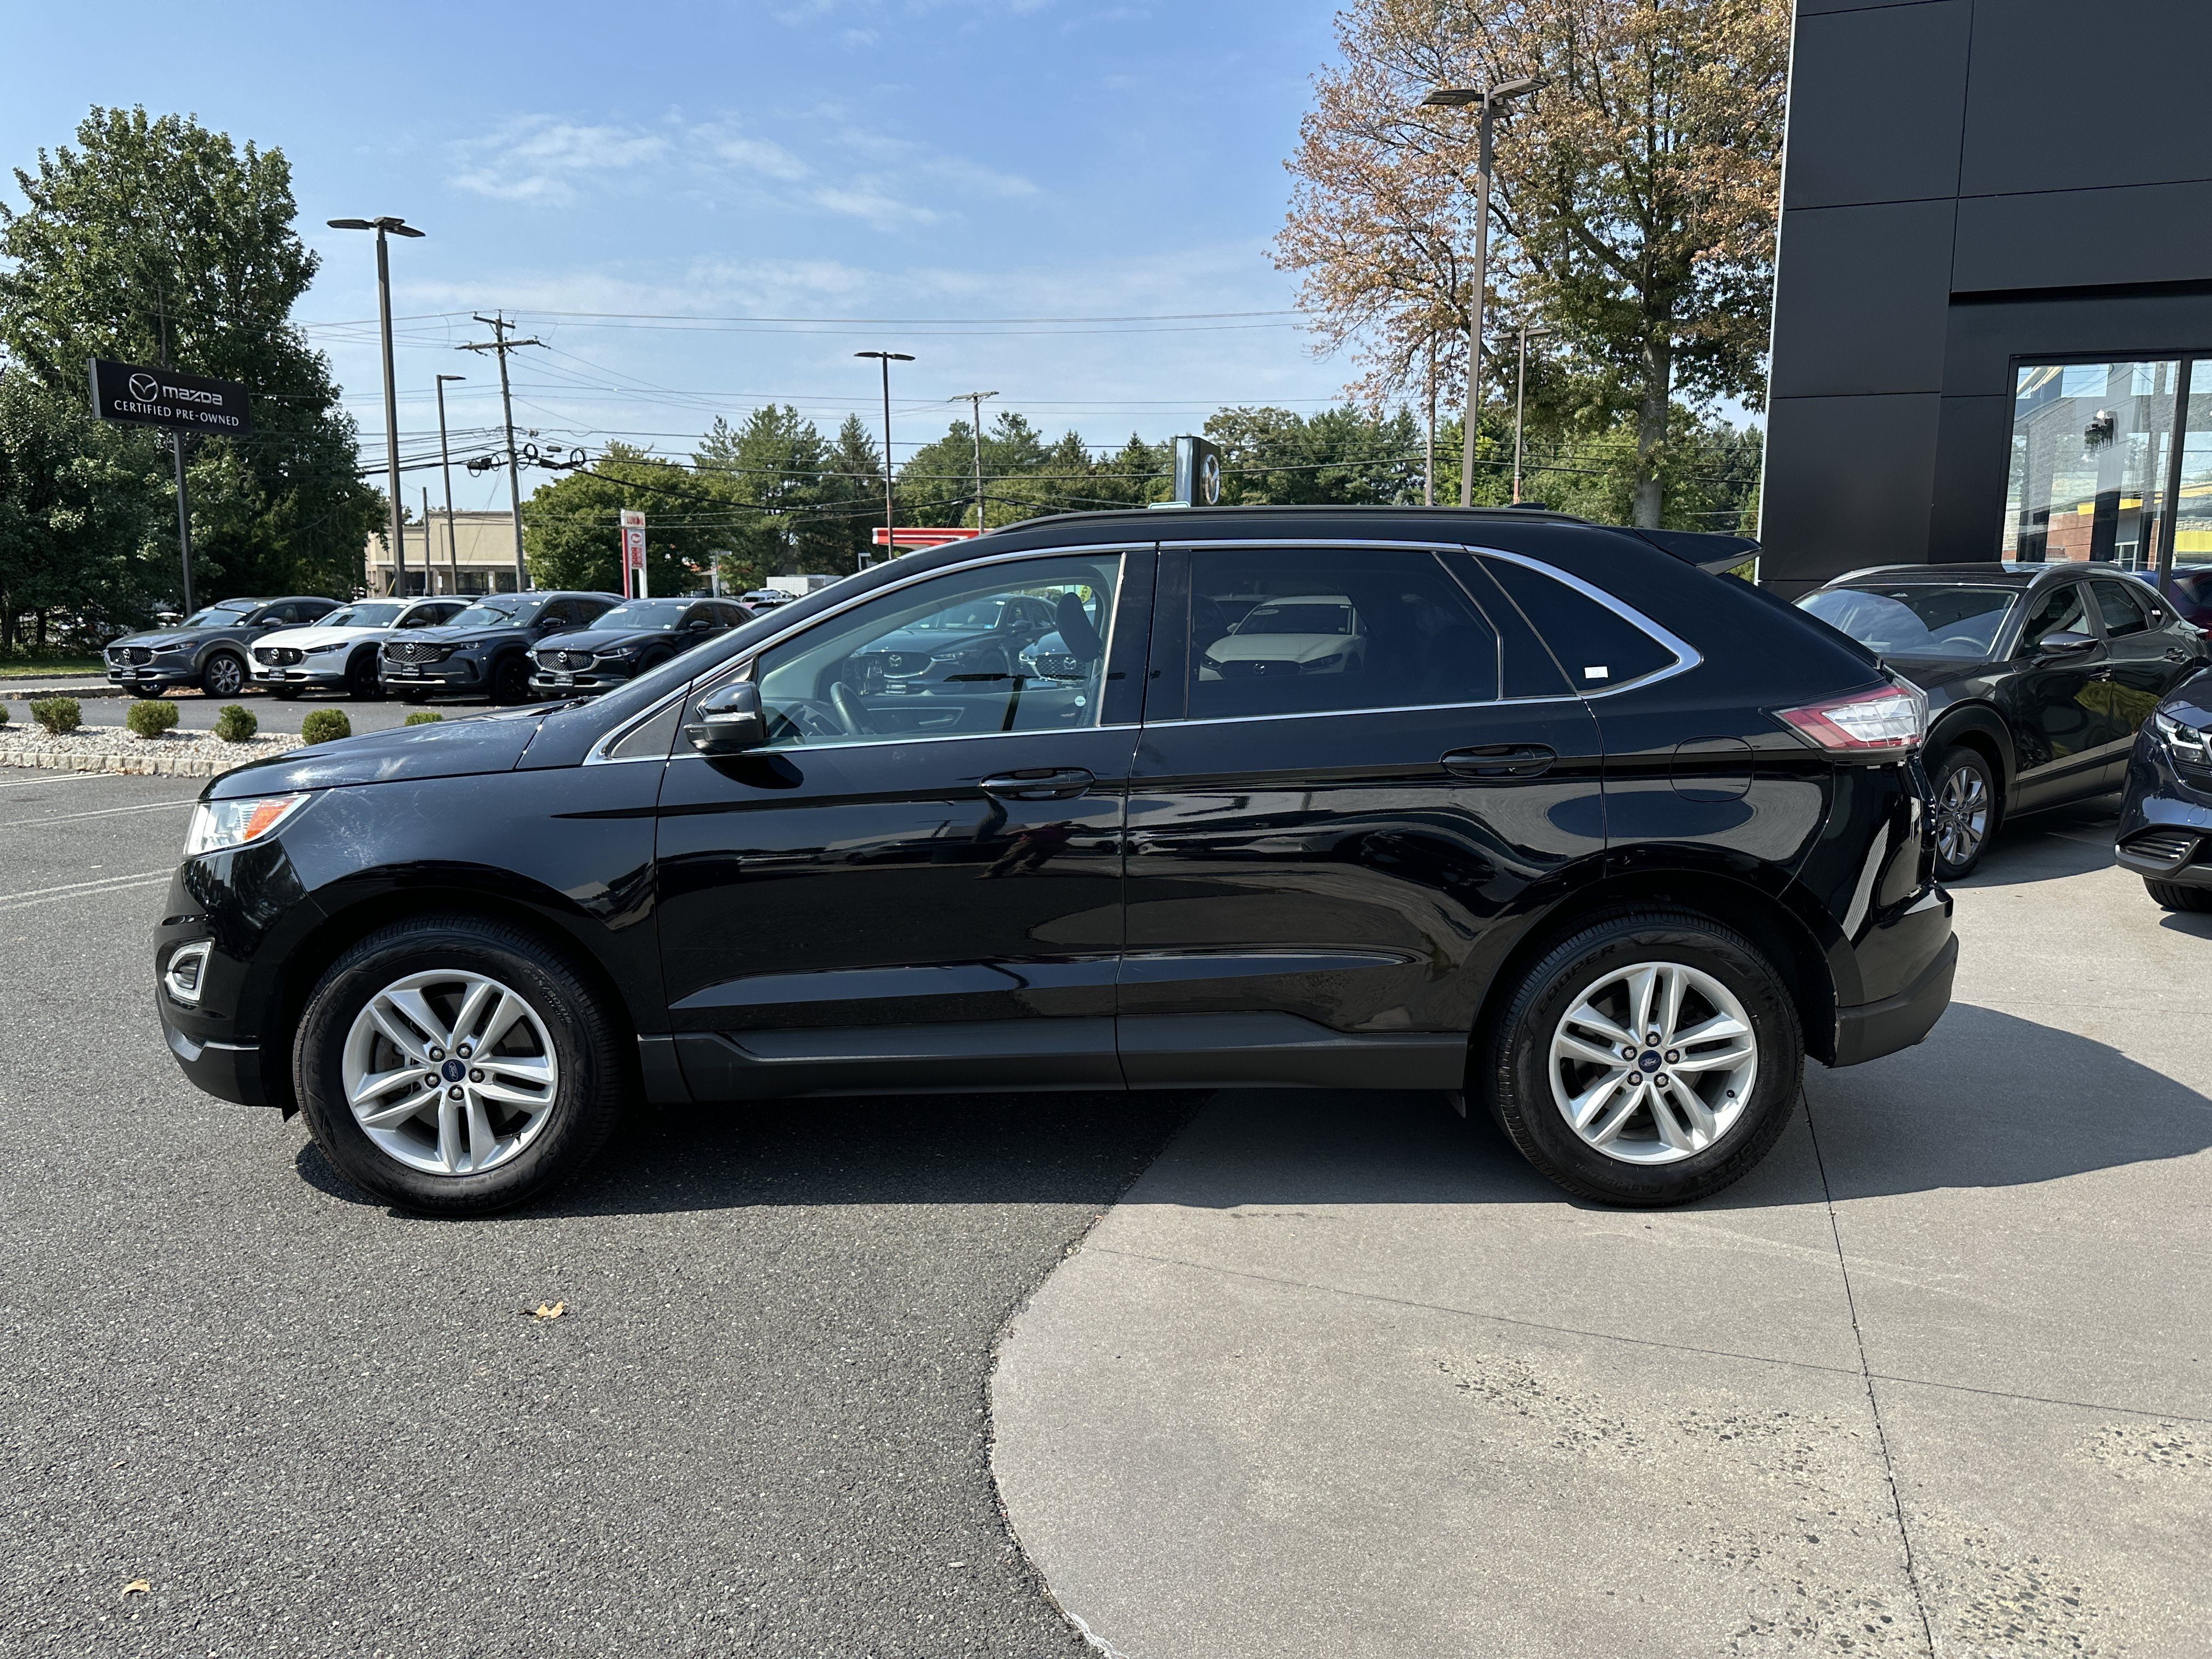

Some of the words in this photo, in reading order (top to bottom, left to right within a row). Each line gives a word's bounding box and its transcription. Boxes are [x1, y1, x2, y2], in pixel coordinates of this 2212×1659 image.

[114, 400, 171, 417] CERTIFIED
[176, 408, 239, 426] PRE-OWNED
[1536, 941, 1617, 1016] COOPER
[1696, 1114, 1775, 1189] COOPER
